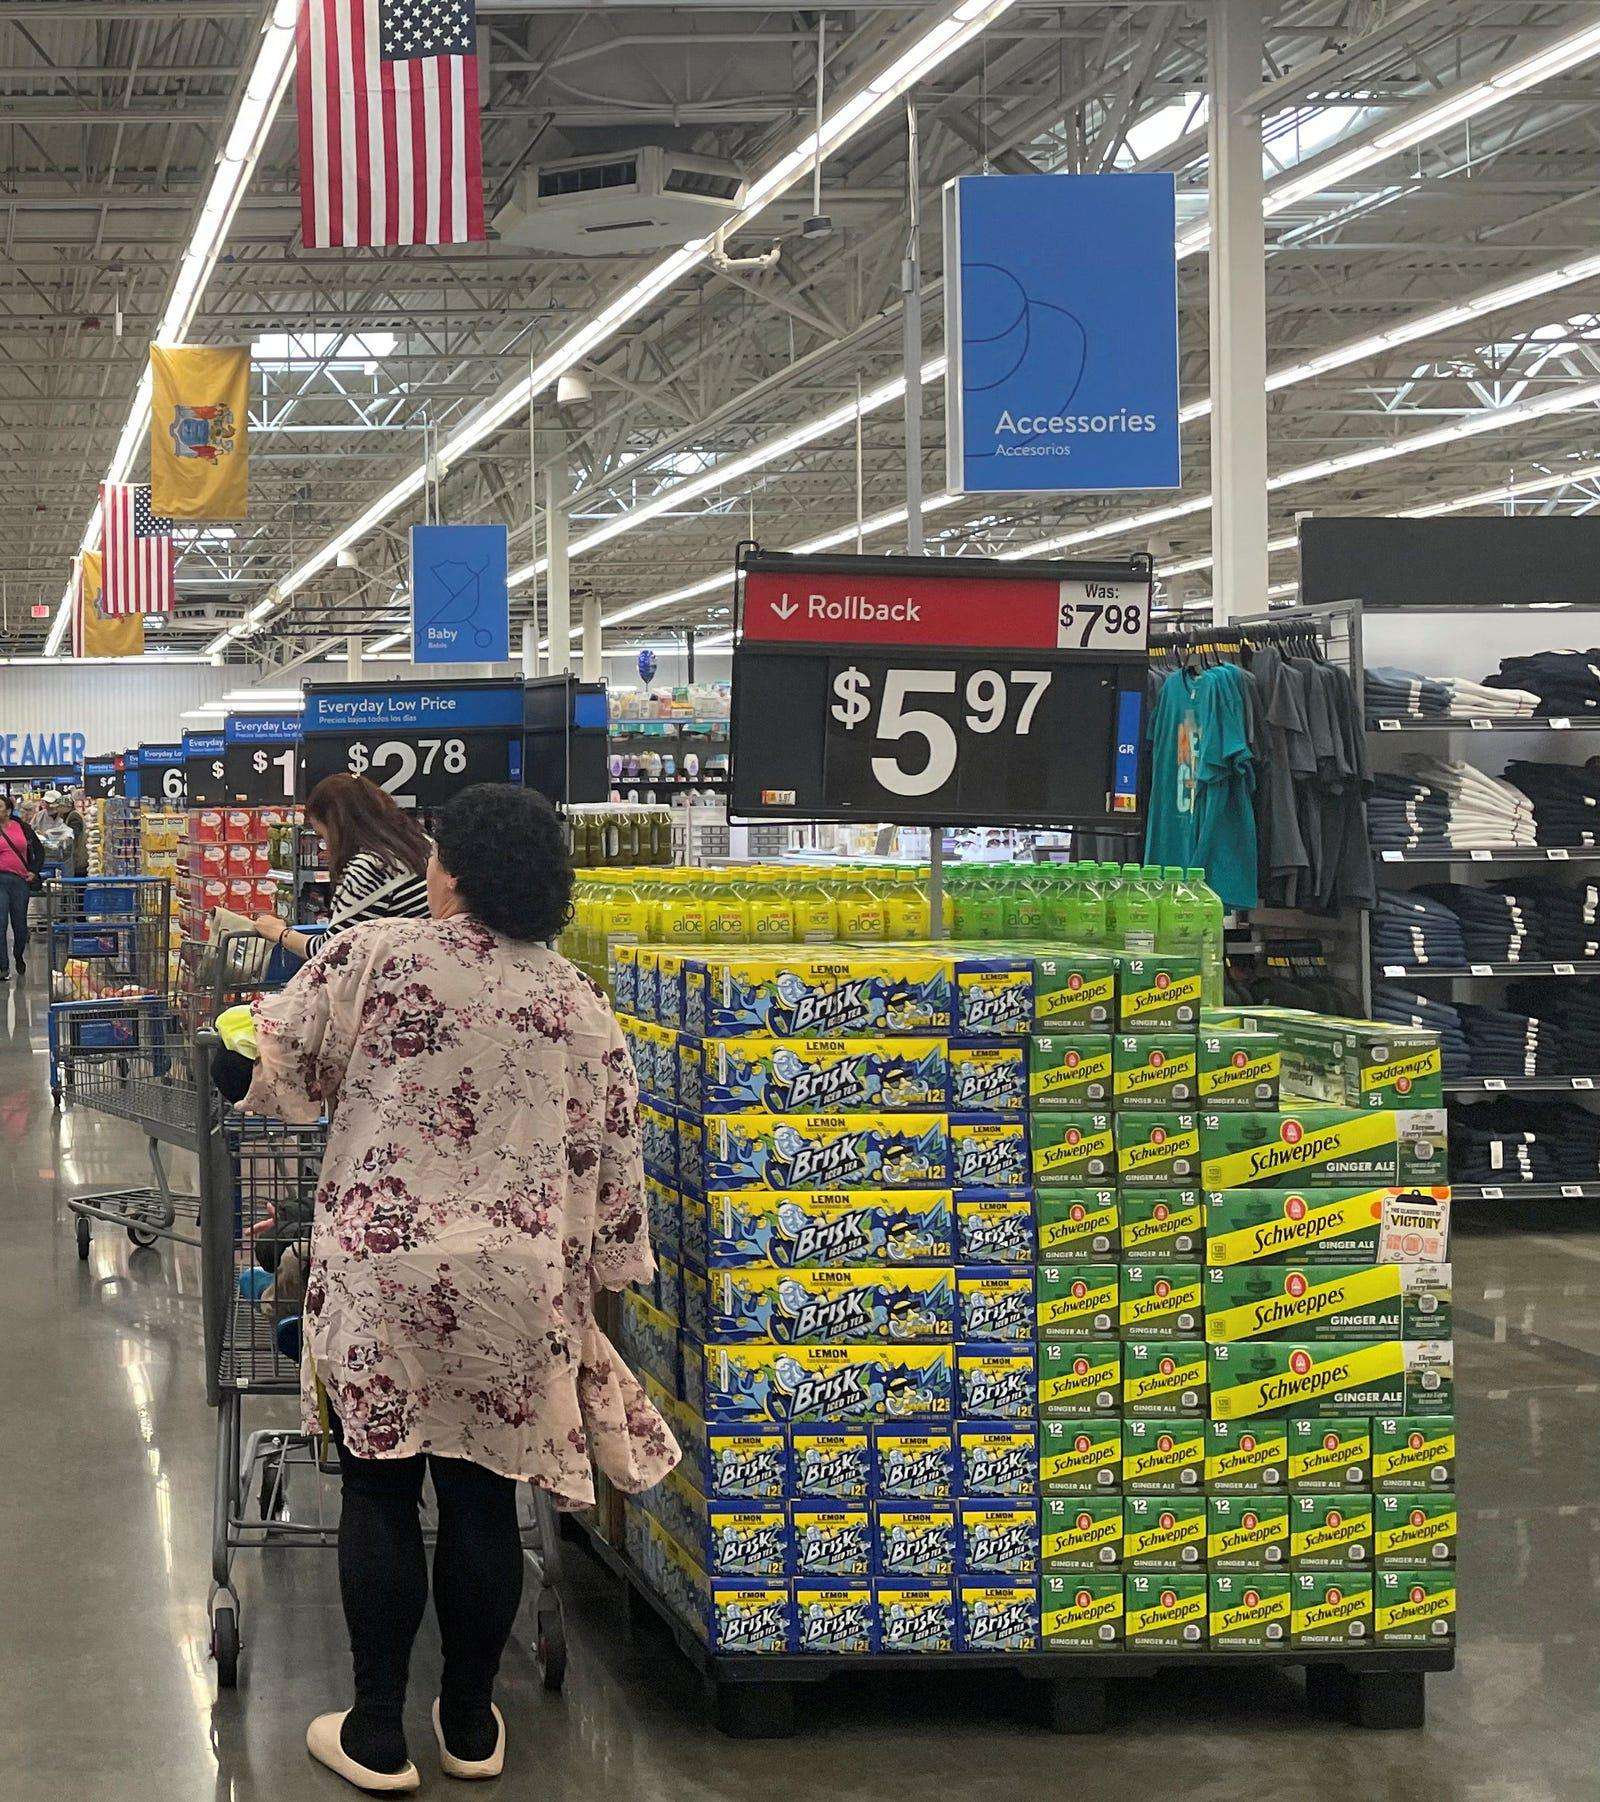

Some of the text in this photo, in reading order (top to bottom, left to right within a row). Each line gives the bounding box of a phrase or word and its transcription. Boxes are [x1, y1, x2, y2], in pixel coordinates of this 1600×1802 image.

[994, 408, 1157, 435] Accessories
[994, 443, 1071, 457] Accesorios
[1085, 584, 1119, 599] Was:
[807, 594, 921, 623] Rollback
[428, 628, 457, 641] Baby
[318, 697, 456, 715] Everyday Low Price
[235, 721, 279, 732] Everyday
[189, 739, 224, 748] Everyday
[1119, 744, 1135, 755] GR
[709, 916, 743, 933] aloe
[757, 916, 790, 933] aloe
[848, 915, 881, 932] aloe
[1007, 910, 1041, 929] aloe
[810, 964, 850, 974] LEMON
[1041, 961, 1056, 971] 12
[1047, 982, 1108, 1012] Schweppes
[1134, 984, 1194, 1011] Schweppes
[806, 1041, 845, 1051] LEMON
[1127, 1060, 1189, 1089] Schweppes
[1211, 1061, 1273, 1089] Schweppes
[807, 1118, 846, 1128] LEMON
[1204, 1116, 1219, 1126] 12
[1249, 1133, 1341, 1178] Schweppes
[1326, 1162, 1396, 1172] GINGER ALE
[811, 1195, 850, 1204] LEMON
[1209, 1192, 1223, 1202] 12
[1390, 1214, 1441, 1230] VICTORY
[1253, 1210, 1344, 1254] Schweppes
[1318, 1240, 1375, 1250] GINGER ALE
[812, 1272, 851, 1282] LEMON
[1133, 1290, 1195, 1319] Schweppes
[1253, 1287, 1344, 1331] Schweppes
[1330, 1316, 1374, 1326] GINGER
[1377, 1315, 1400, 1325] ALE
[808, 1349, 848, 1359] LEMON
[1214, 1347, 1229, 1356] 12
[1258, 1364, 1348, 1408] Schweppes
[1334, 1392, 1402, 1402] GINGER ALE
[1053, 1446, 1114, 1474] Schweppes
[1387, 1443, 1448, 1470] Schweppes
[1222, 1523, 1281, 1551] Schweppes
[1139, 1601, 1200, 1629] Schweppes
[1389, 1597, 1449, 1625] Schweppes
